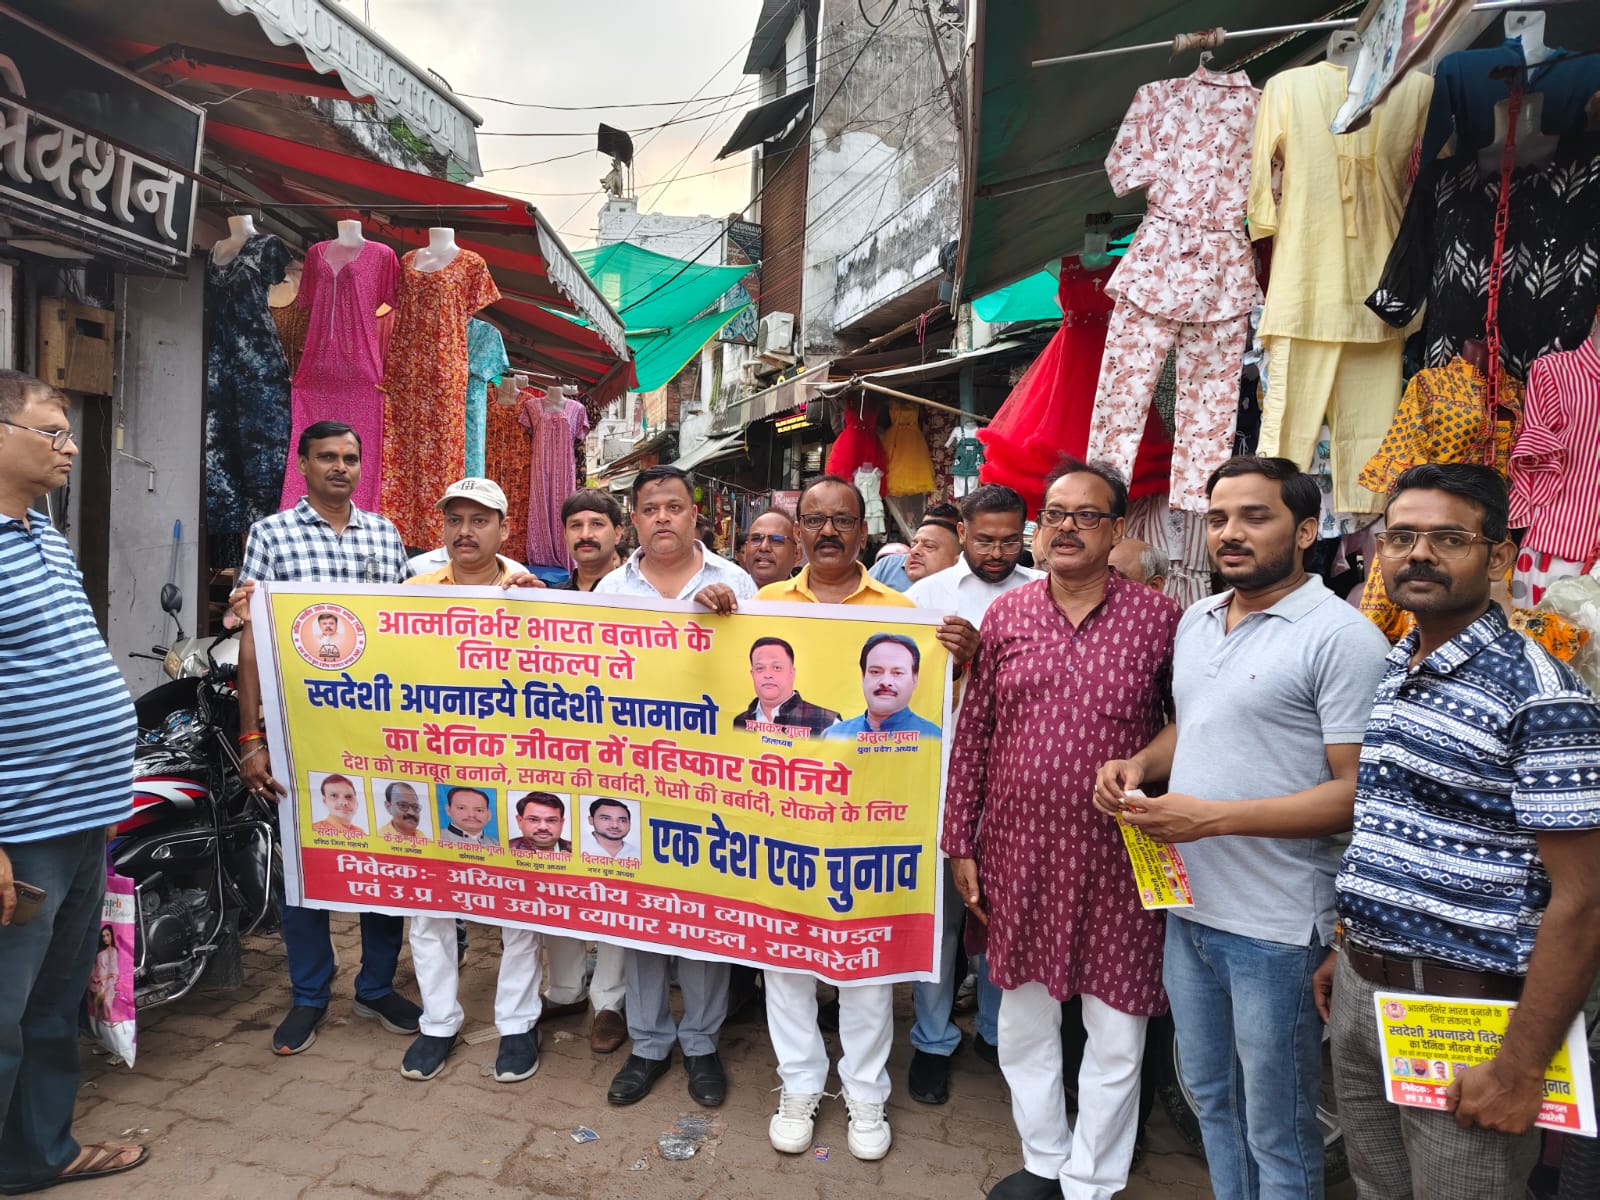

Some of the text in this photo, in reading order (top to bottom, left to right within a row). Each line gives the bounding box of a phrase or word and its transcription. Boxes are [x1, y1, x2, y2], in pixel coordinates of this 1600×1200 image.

[378, 606, 521, 639] आत्मनिर्भर
[527, 617, 594, 644] भारत
[599, 620, 679, 650] बनाने
[684, 621, 713, 652] के
[456, 640, 635, 680] लिए संकल्प ले
[303, 673, 719, 735] स्वदेशी अपनाइये विदेशी सामानो
[342, 751, 908, 823] देश को मजबूत बनाने, समय की बर्बादी, पैसो की बर्बादी, रोकने के लिए
[382, 723, 852, 796] का दैनिक जीवन में बहिष्कार कीजिये
[648, 813, 923, 913] एक देश एक चुनाव
[346, 877, 381, 897] एवं
[450, 888, 496, 911] युवा
[503, 897, 571, 921] उद्योग
[578, 906, 660, 934] व्यापार
[764, 940, 880, 972] रायबरेली
[446, 868, 526, 892] अखिल
[534, 880, 629, 906] भारतीय
[635, 893, 706, 919] उद्योग
[714, 905, 800, 937] व्यापार
[806, 923, 893, 945] मण्डल
